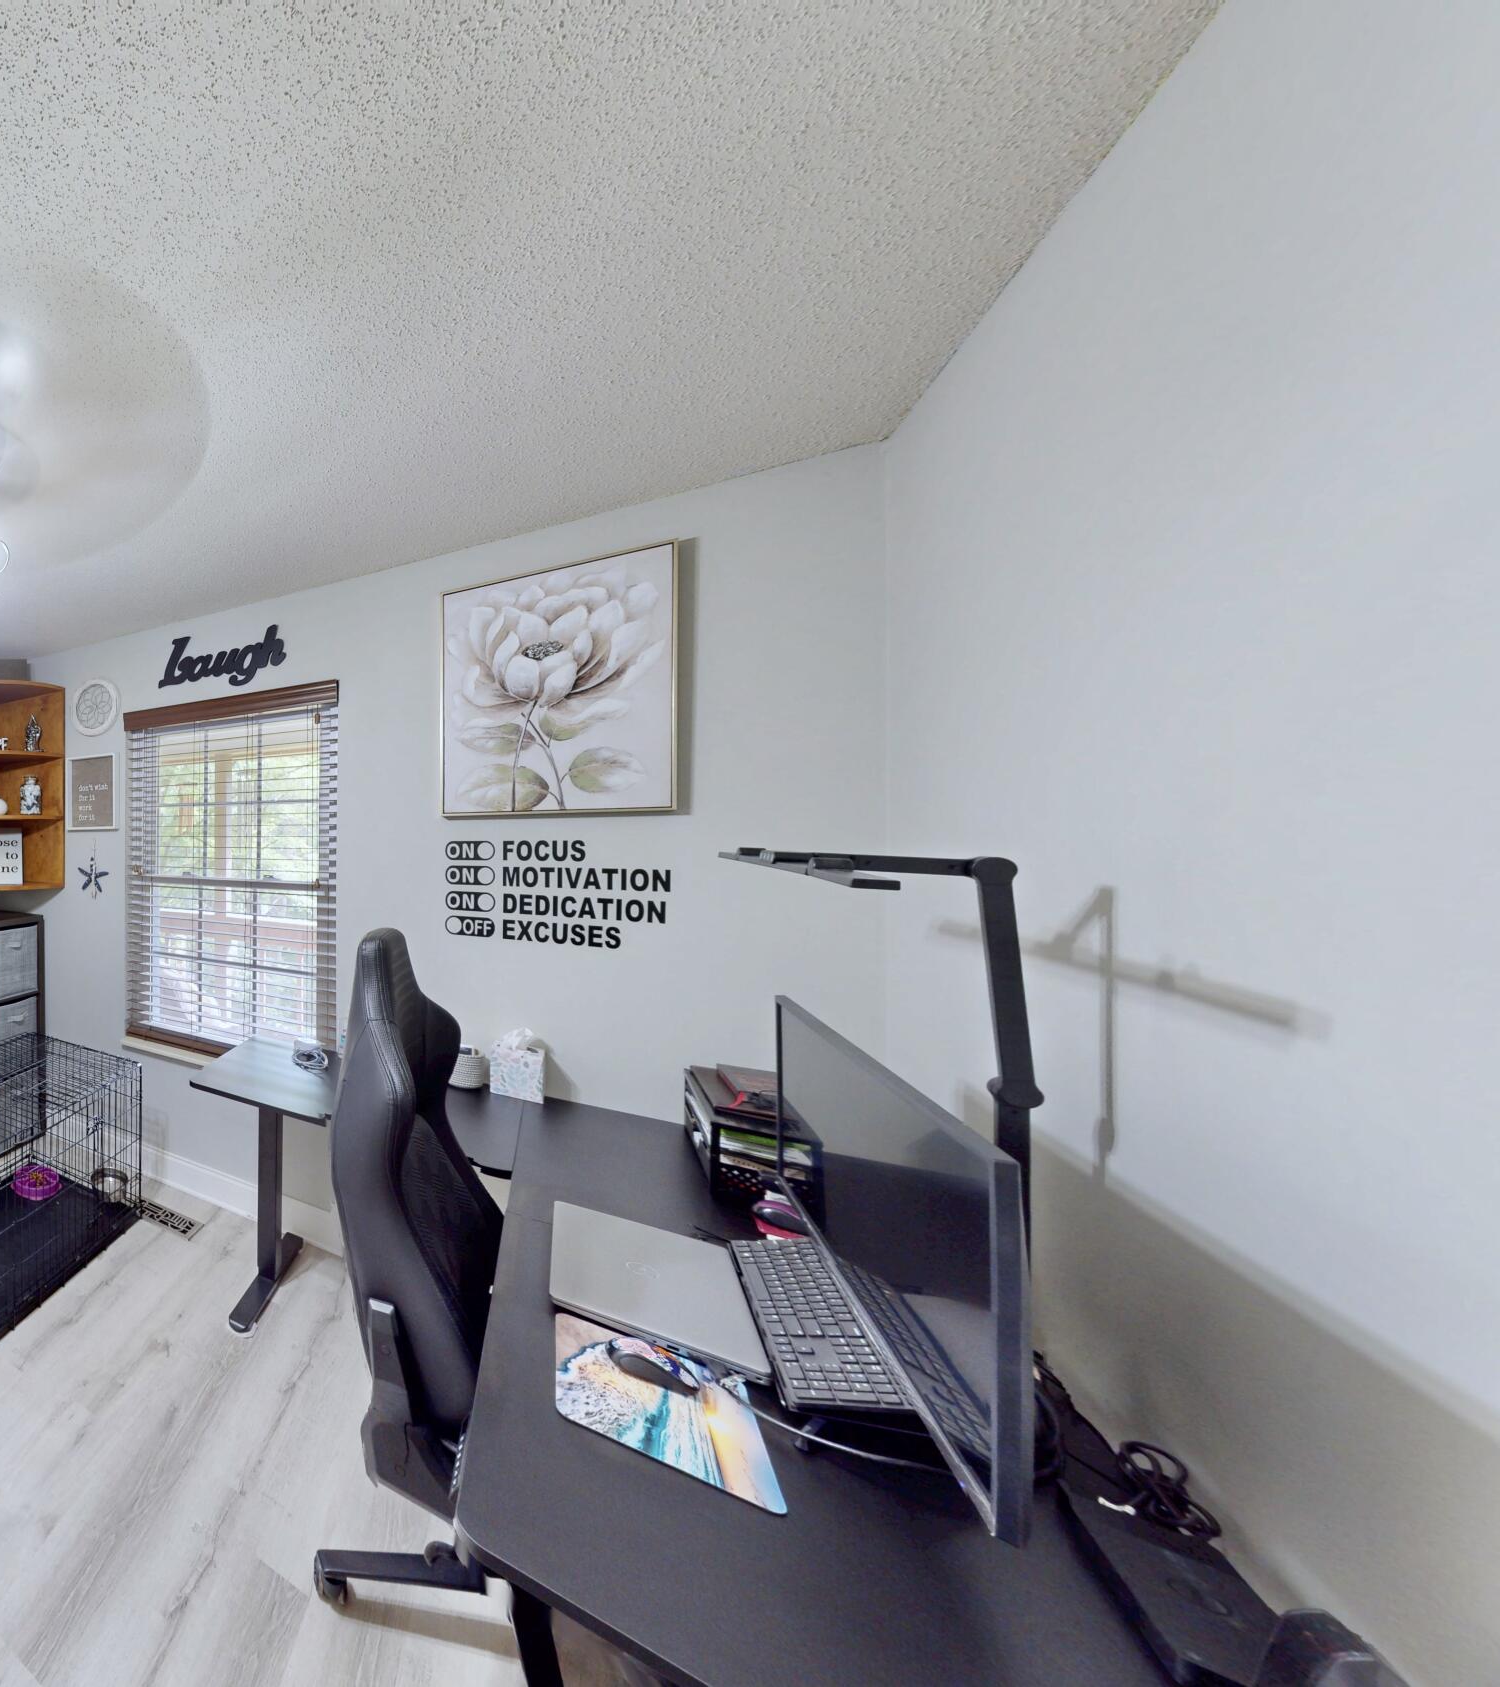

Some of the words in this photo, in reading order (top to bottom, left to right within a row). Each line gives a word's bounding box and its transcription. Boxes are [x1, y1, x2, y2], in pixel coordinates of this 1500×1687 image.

[158, 624, 286, 688] Laugh
[6, 852, 18, 860] to
[446, 843, 475, 859] ON
[502, 840, 586, 861] FOCUS
[446, 868, 475, 883] ON
[502, 867, 671, 892] MOTIVATION
[446, 893, 475, 909] ON
[502, 894, 666, 924] DEDICATION
[463, 921, 492, 936] OFF
[502, 919, 621, 949] EXCUSES
